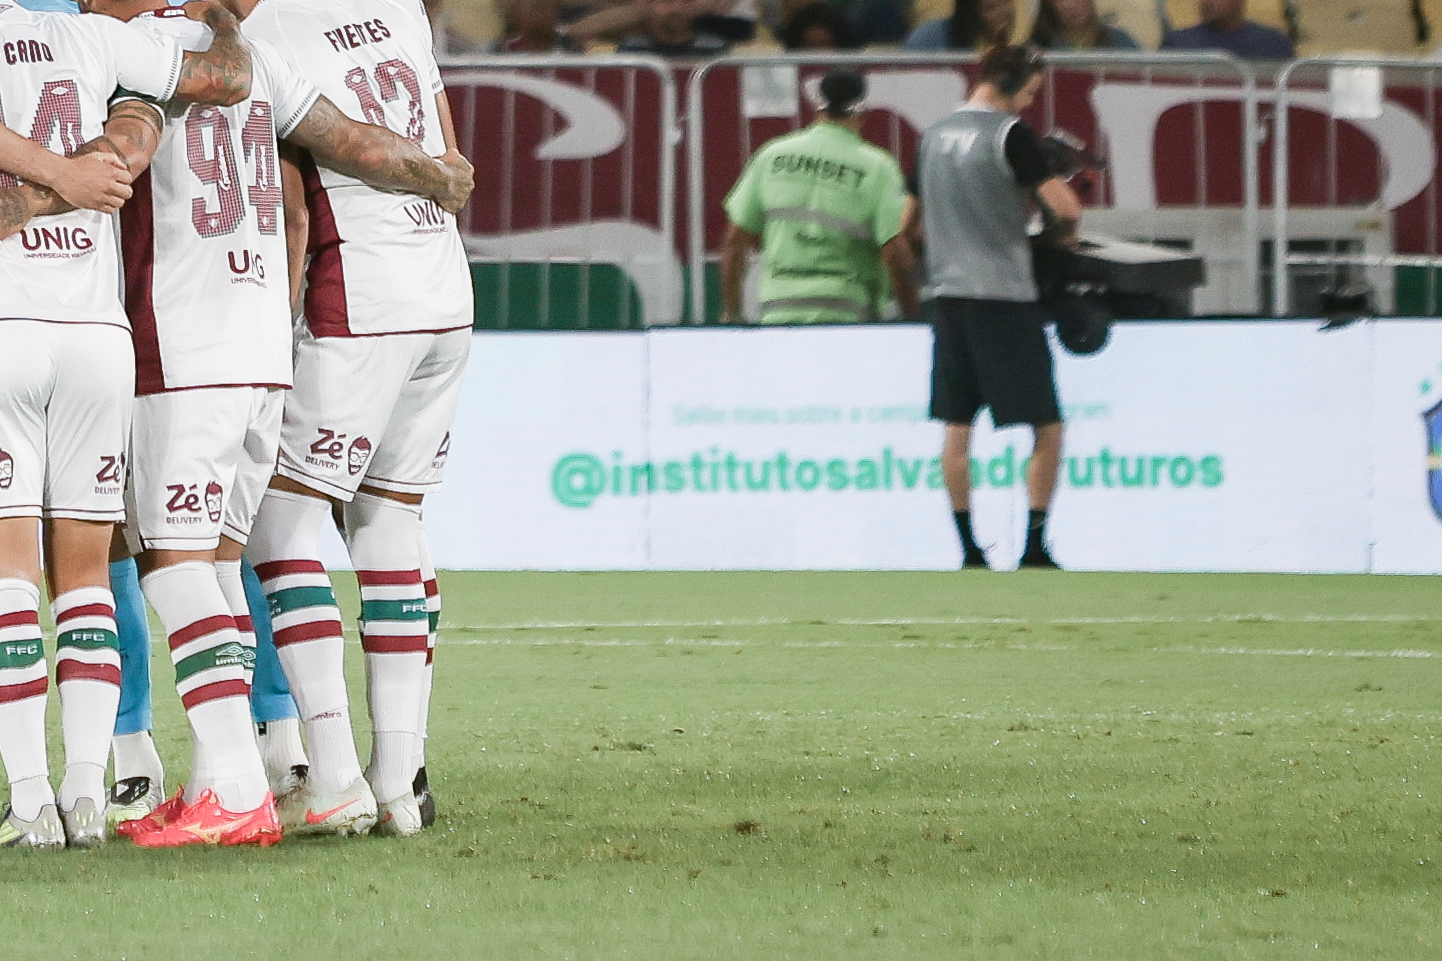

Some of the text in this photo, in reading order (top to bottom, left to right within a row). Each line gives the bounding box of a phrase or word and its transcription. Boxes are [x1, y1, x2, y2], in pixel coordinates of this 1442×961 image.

[4, 39, 54, 65] CANO
[184, 100, 283, 239] 94
[772, 155, 866, 187] SUNSET
[20, 227, 93, 251] UNIG
[310, 428, 346, 460] Zé
[96, 454, 121, 485] Zé
[305, 455, 340, 471] DELIVERY
[551, 444, 1224, 508] @institutosalvaduturos
[165, 483, 203, 514] Zé
[166, 515, 203, 525] DELIVERY
[6, 644, 38, 656] FFC
[72, 633, 105, 642] FFC
